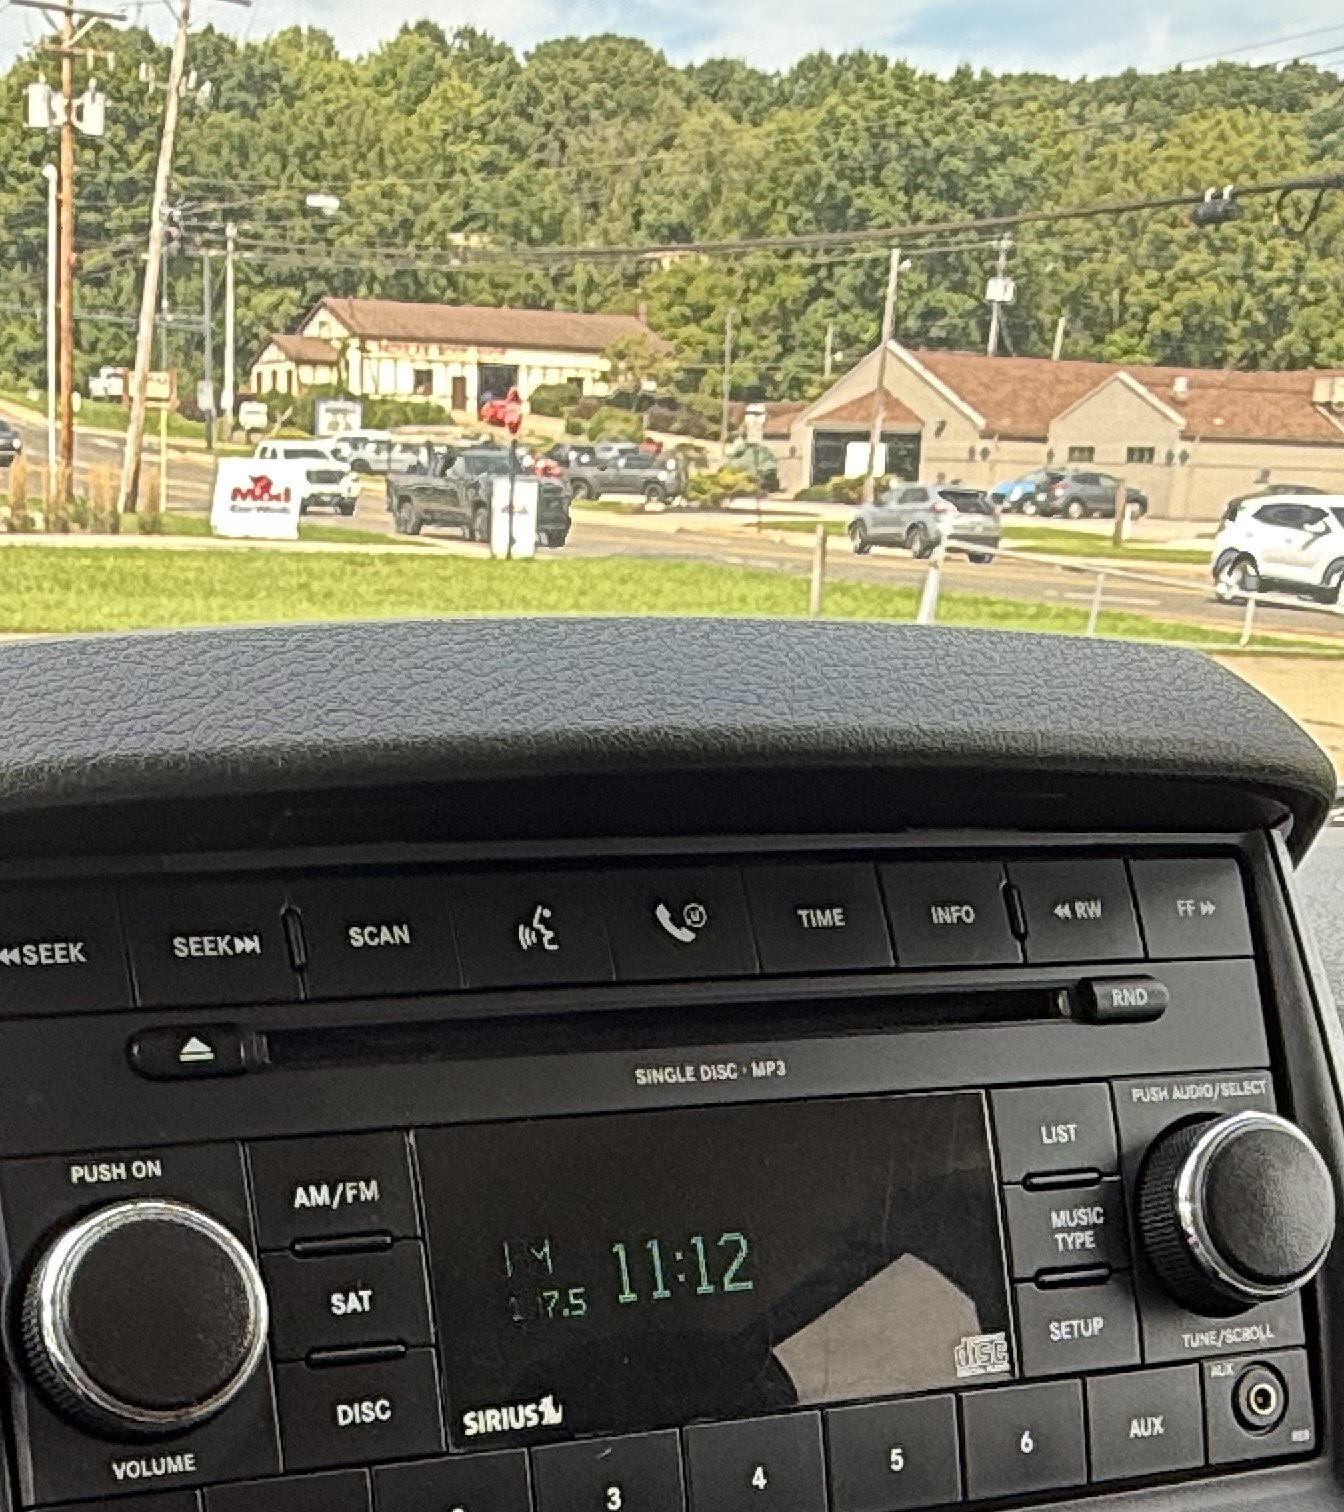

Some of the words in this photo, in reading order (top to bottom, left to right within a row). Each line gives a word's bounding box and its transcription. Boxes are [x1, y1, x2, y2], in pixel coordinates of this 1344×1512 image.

[796, 908, 846, 928] TIME
[930, 905, 976, 924] INFO
[1074, 900, 1102, 920] RW
[1176, 899, 1196, 917] FF
[172, 934, 234, 958] SEEK
[348, 924, 410, 948] SCAN
[22, 942, 87, 966] SEEK
[1111, 986, 1149, 1006] RND
[634, 1065, 697, 1085] SINGLE
[699, 1062, 738, 1082] DISC
[750, 1060, 786, 1078] MP3
[1131, 1086, 1170, 1103] PUSH
[1172, 1078, 1268, 1101] AUDIO/SELECT
[1040, 1123, 1078, 1144] LIST
[70, 1162, 127, 1184] PUSH
[130, 1160, 162, 1179] ON
[294, 1180, 380, 1210] AM/FM
[1050, 1206, 1105, 1229] MUSIC
[1054, 1229, 1096, 1253] TYPE
[612, 1231, 755, 1304] 11:12
[330, 1290, 372, 1316] SAT
[1048, 1316, 1104, 1342] SETUP
[1181, 1321, 1276, 1348] TUNE/SCROLL
[336, 1398, 392, 1426] DISC
[462, 1402, 540, 1436] SIRIUS
[1129, 1415, 1165, 1438] AUX
[1020, 1430, 1034, 1454] 6
[112, 1453, 196, 1480] VOLUME
[890, 1448, 904, 1472] 5
[752, 1466, 768, 1490] 4
[606, 1486, 622, 1511] 3
